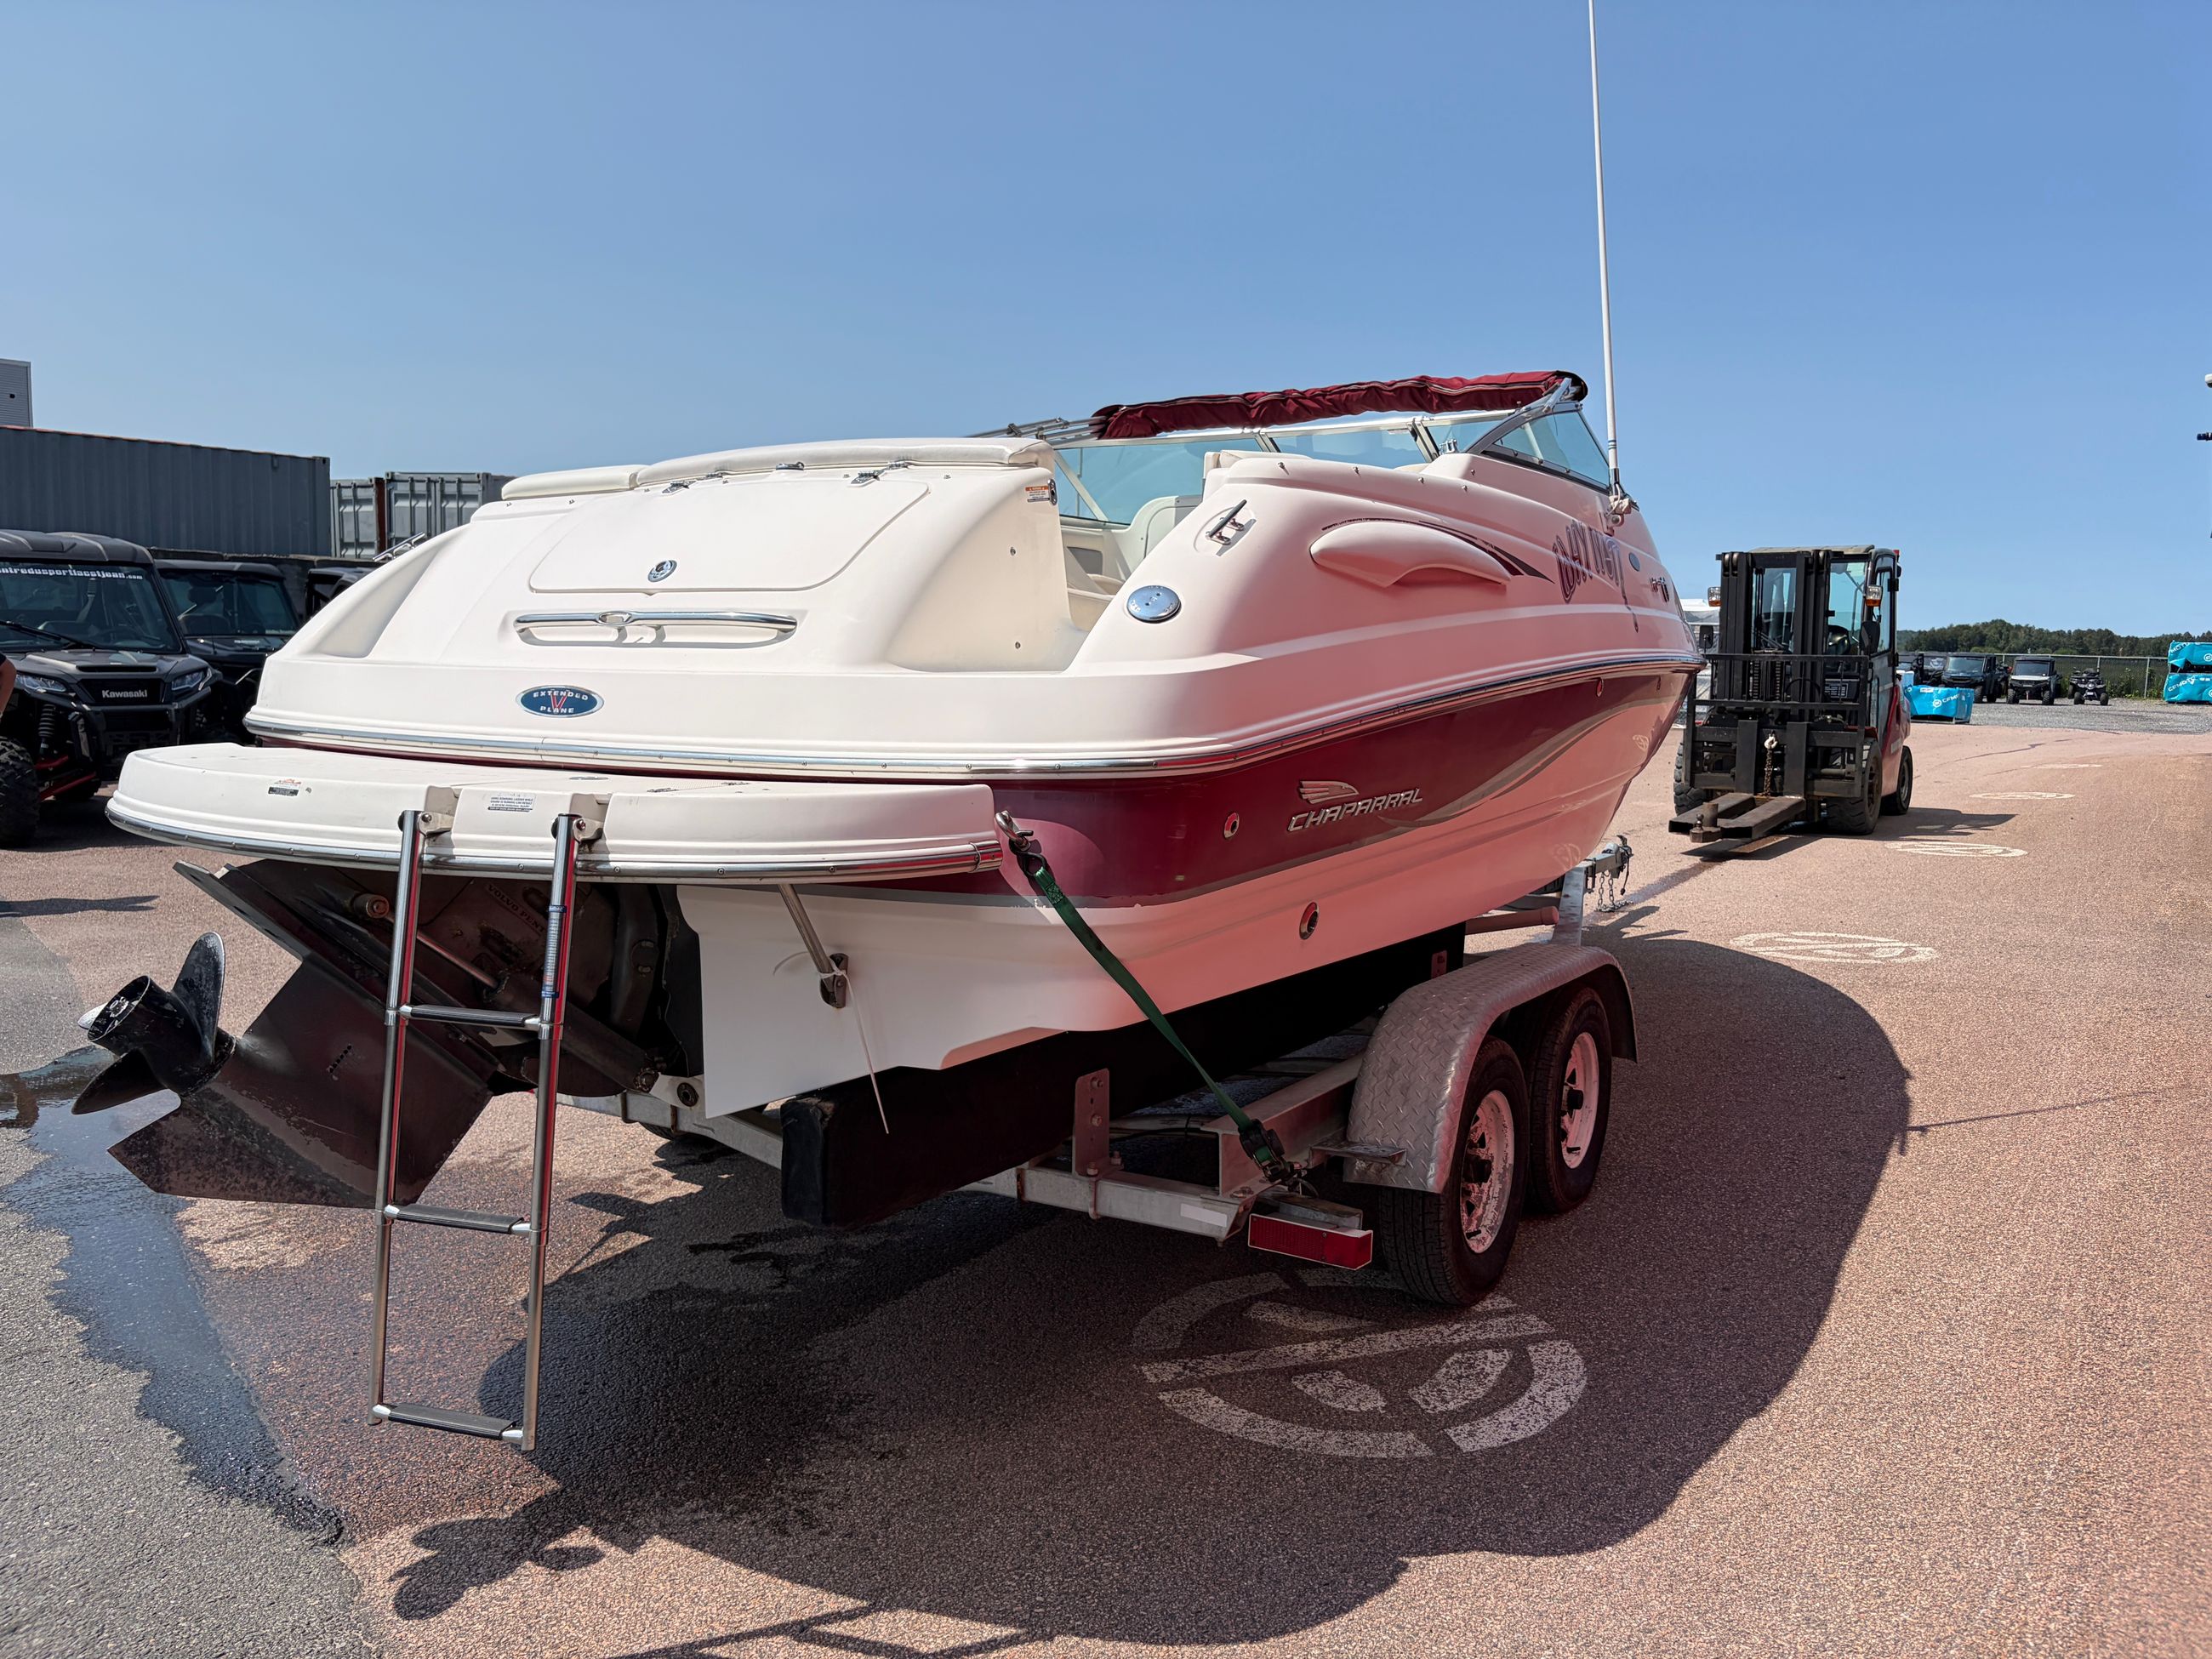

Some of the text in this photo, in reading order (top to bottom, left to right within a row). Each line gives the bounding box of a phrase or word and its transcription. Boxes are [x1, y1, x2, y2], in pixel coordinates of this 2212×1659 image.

[0, 567, 143, 579] ntredusportlacstjean.com
[102, 689, 148, 698] Kawasaki
[533, 690, 589, 701] EXTENDED
[539, 705, 575, 714] PLANE
[1286, 788, 1423, 832] CHAPARRAL
[488, 885, 546, 934] VOLVO PENT
